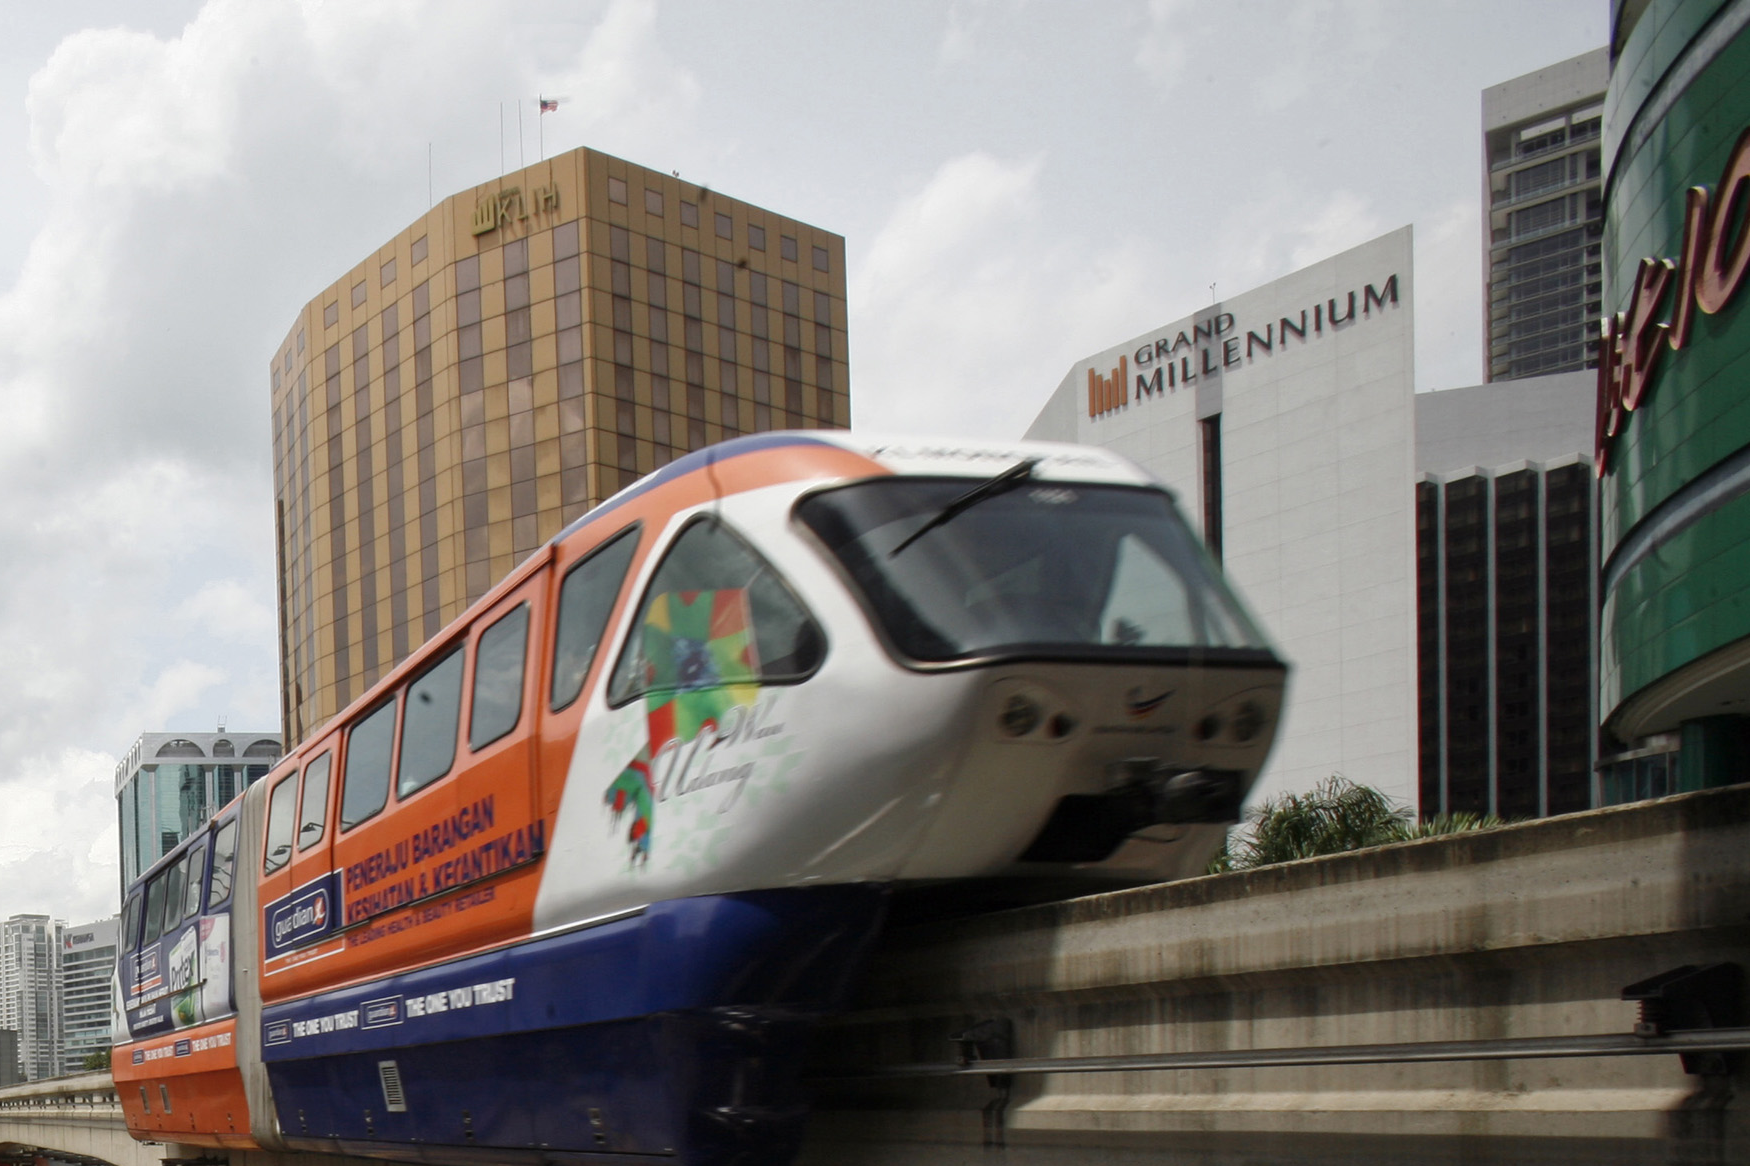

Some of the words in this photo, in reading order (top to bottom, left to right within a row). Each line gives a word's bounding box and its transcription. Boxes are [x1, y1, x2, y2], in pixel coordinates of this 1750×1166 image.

[1133, 312, 1235, 365] GRAND
[1135, 273, 1399, 401] MILLENNIUM
[346, 839, 409, 894] PENERAJU
[413, 794, 495, 864] BARANGAN
[419, 872, 428, 896] &
[406, 999, 425, 1018] THE
[425, 992, 448, 1013] ONE
[449, 986, 472, 1010] YOU
[473, 978, 515, 1004] TRUST
[293, 1022, 306, 1038] THE
[306, 1019, 320, 1035] ONE
[320, 1016, 334, 1032] YOU
[335, 1010, 359, 1031] TRUST
